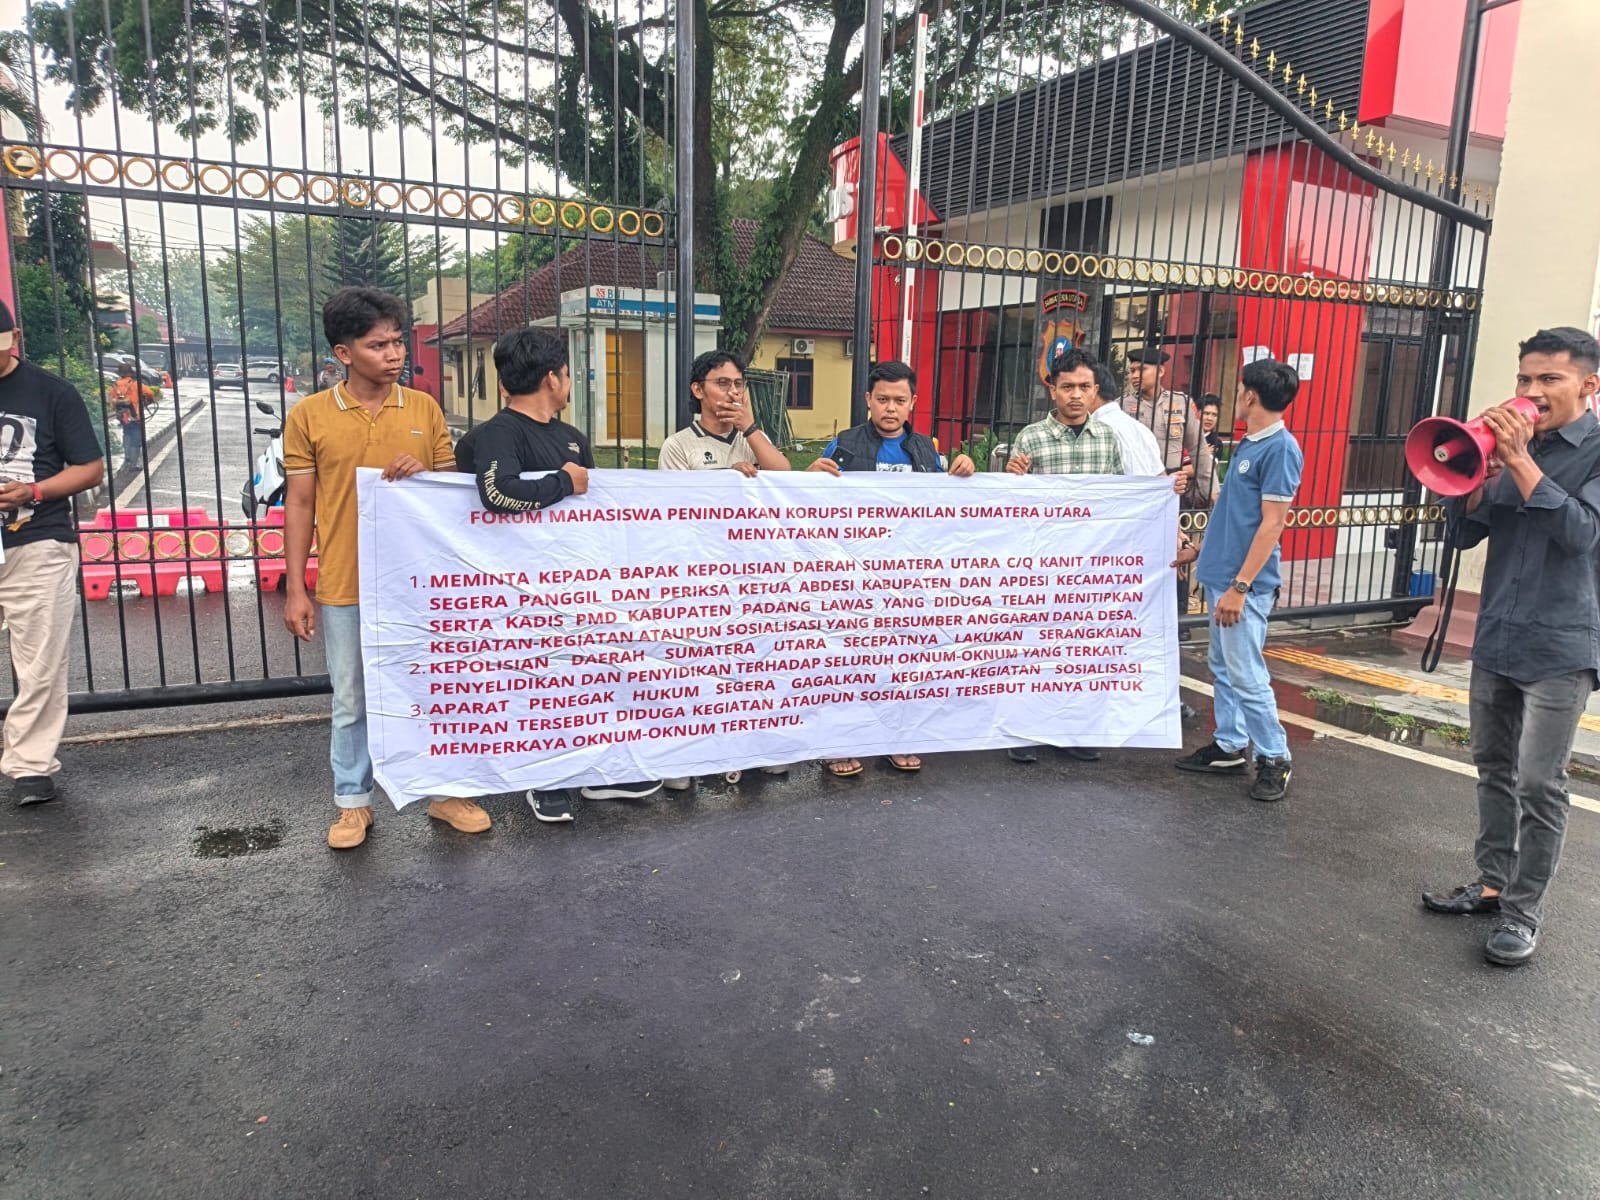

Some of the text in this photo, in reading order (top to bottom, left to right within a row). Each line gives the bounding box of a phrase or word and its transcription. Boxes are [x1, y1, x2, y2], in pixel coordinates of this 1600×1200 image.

[596, 300, 616, 308] ATM
[470, 506, 1091, 526] FORUM MAHASISWA PENINDAKAN KORUPSI PERWAKILAN SUMATERA UTARA
[727, 527, 893, 541] MENYATAKAN SIKAP:
[409, 555, 1144, 590] 1. MEMINTA KEPADA BAPAK KEPOLISIAN DAERAH SUMATERA UTARA C/Q KANIT TIPIKOR
[430, 573, 1143, 611] SEGERA PANGGIL DAN PERIKSA KETUA ABDESI KABUPATEN DAN APDESI KECAMATAN
[429, 609, 1138, 655] KEGIATAN-KEGIATAN ATAUPUN SOSIALISASI YANG BERSUMBER ANGGARAN DANA DESA.
[430, 591, 1143, 634] SERTA KADIS PMD KABUPATEN PADANG LAWAS YANG DIDUGA TELAH MENITIPKAN
[408, 627, 1142, 675] 2. KEPOLISIAN DAERAH SUMATERA UTARA SECEPATNYA LAKUKAN SERANGKAIAN
[429, 645, 1128, 696] PENYELIDIKAN DAN PENYIDIKAN TERHADAP SELURUH OKNUM-OKNUM YANG TERKAIT.
[409, 663, 1142, 718] 3. APARAT PENEGAK HUKUM SEGERA GAGALKAN KEGIATAN-KEGIATAN SOSIALISASI
[429, 679, 1143, 736] TITIPAN TERSEBUT DIDUGA KEGIATAN ATAUPUN SOSIALISASI TERSEBUT HANYA UNTUK
[429, 715, 803, 757] MEMPERKAYA OKNUM-OKNUM TERTENTU.
